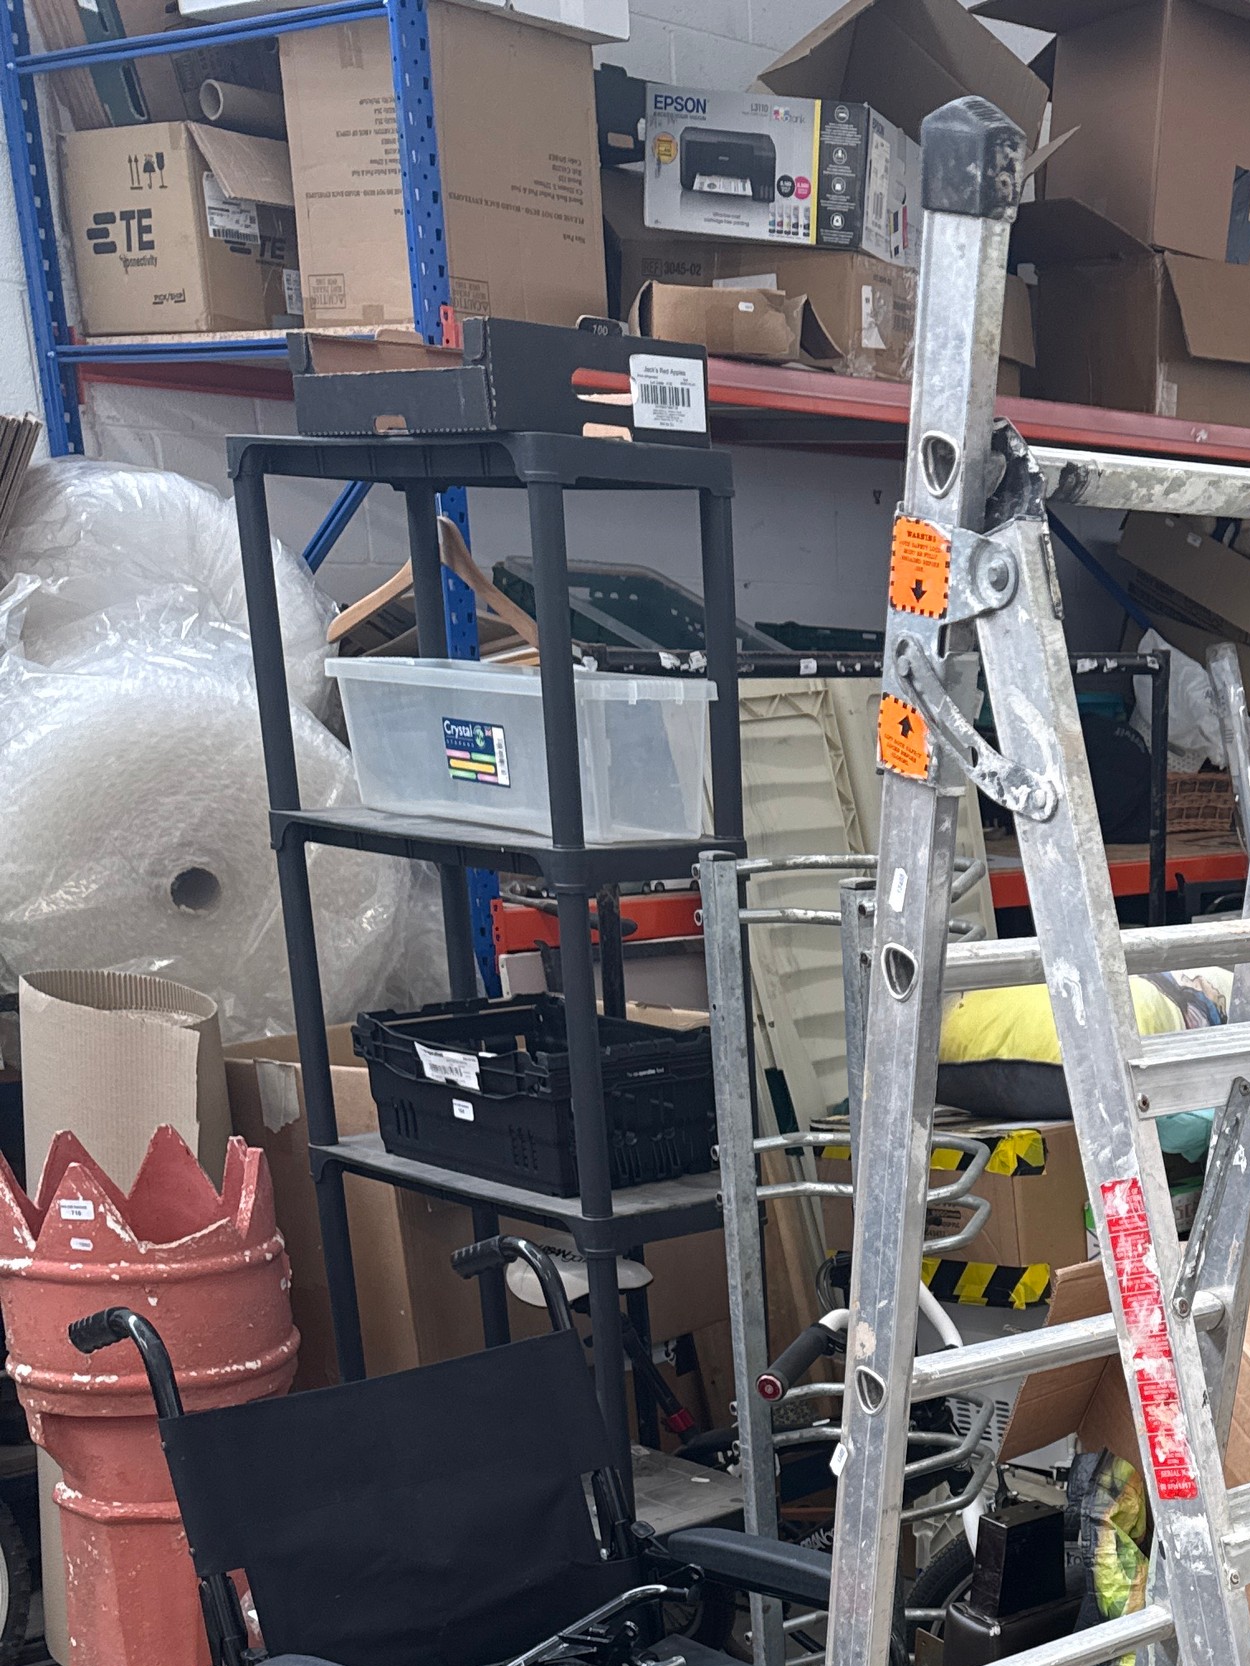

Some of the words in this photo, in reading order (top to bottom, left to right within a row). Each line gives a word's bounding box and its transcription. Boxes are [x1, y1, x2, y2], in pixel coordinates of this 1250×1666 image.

[654, 94, 707, 114] EPSON
[119, 208, 155, 252] TE
[592, 324, 609, 336] 100
[906, 530, 937, 543] WARNING
[443, 720, 473, 739] Crystal
